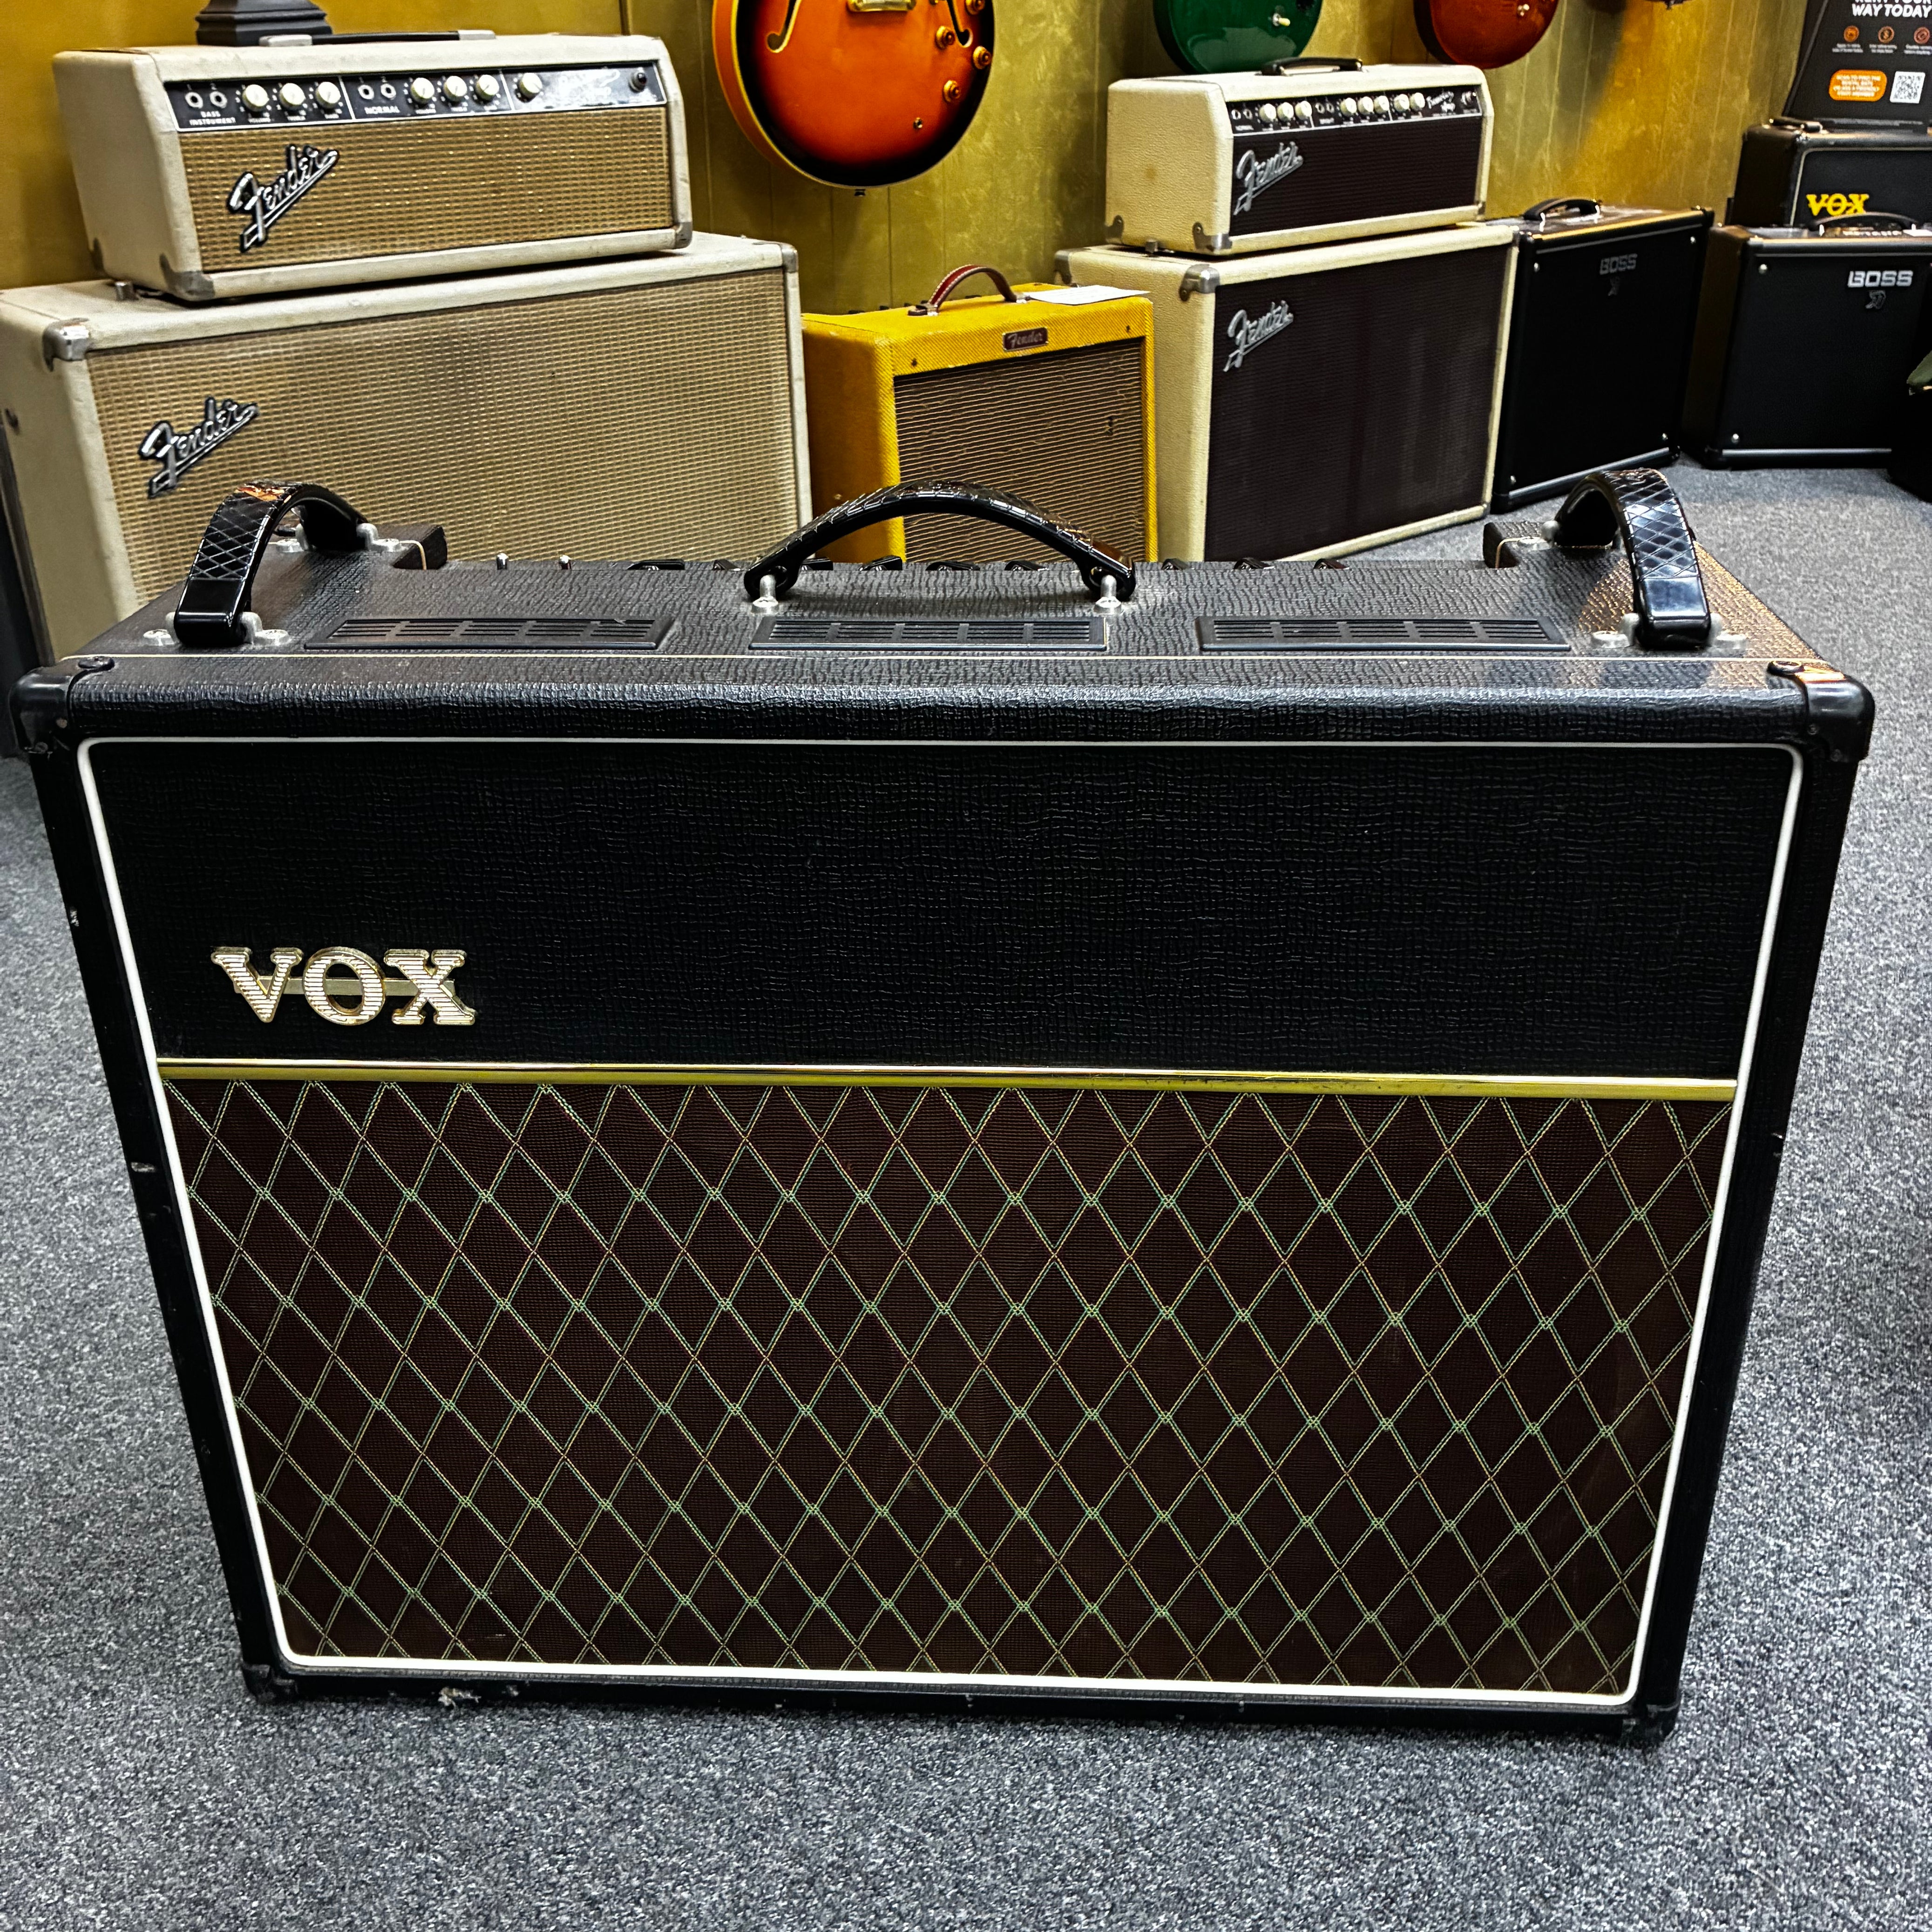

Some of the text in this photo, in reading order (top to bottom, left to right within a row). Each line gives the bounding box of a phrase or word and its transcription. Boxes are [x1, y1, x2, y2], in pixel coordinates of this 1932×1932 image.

[1852, 3, 1932, 18] WAY TODAY
[226, 144, 340, 252] Fender
[1233, 141, 1304, 216] Fender
[1805, 193, 1870, 217] VOX
[1599, 253, 1638, 276] BOSS
[1847, 270, 1913, 288] BOSS
[1007, 331, 1044, 348] Fender
[1222, 299, 1294, 372] Fender
[138, 397, 259, 499] Fender
[210, 946, 478, 1026] VOX
